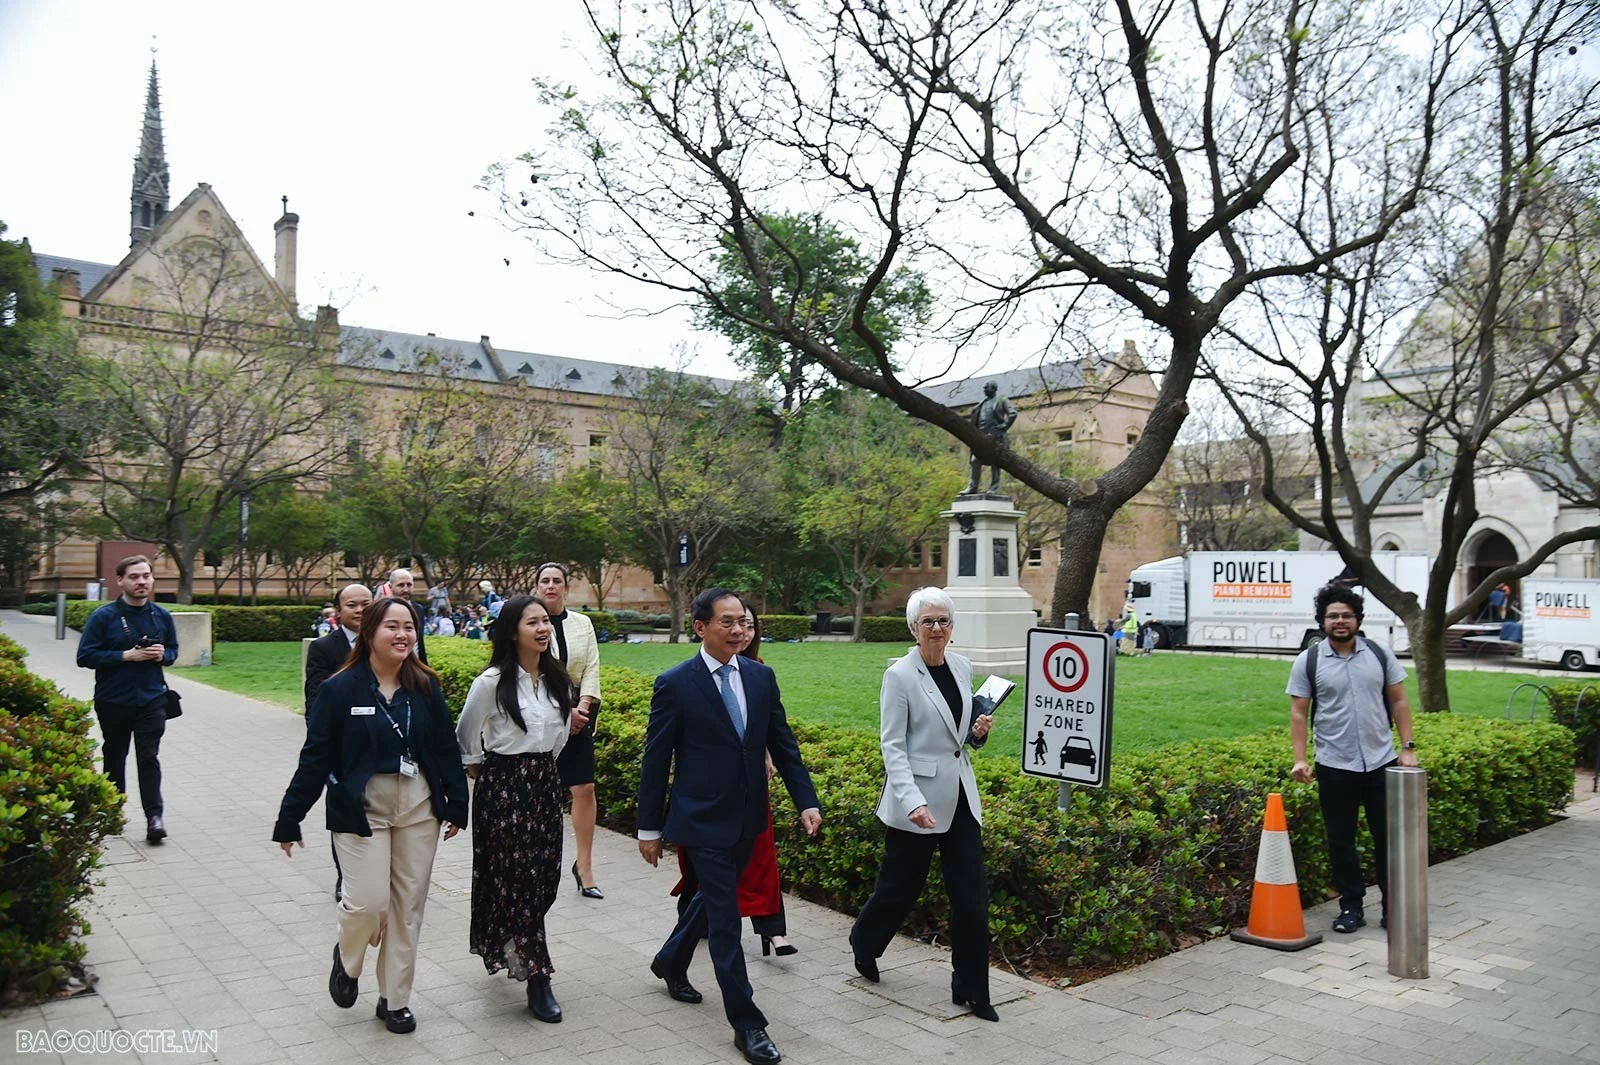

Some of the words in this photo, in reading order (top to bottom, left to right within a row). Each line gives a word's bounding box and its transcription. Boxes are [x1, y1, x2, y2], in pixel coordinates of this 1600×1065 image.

[1213, 561, 1292, 583] POWELL
[1214, 585, 1240, 597] PIANO
[1243, 585, 1292, 598] REMOVALS
[1536, 592, 1590, 608] POWELL
[1055, 656, 1077, 679] 10
[1034, 695, 1095, 715] SHARED
[1044, 714, 1084, 732] ZONE
